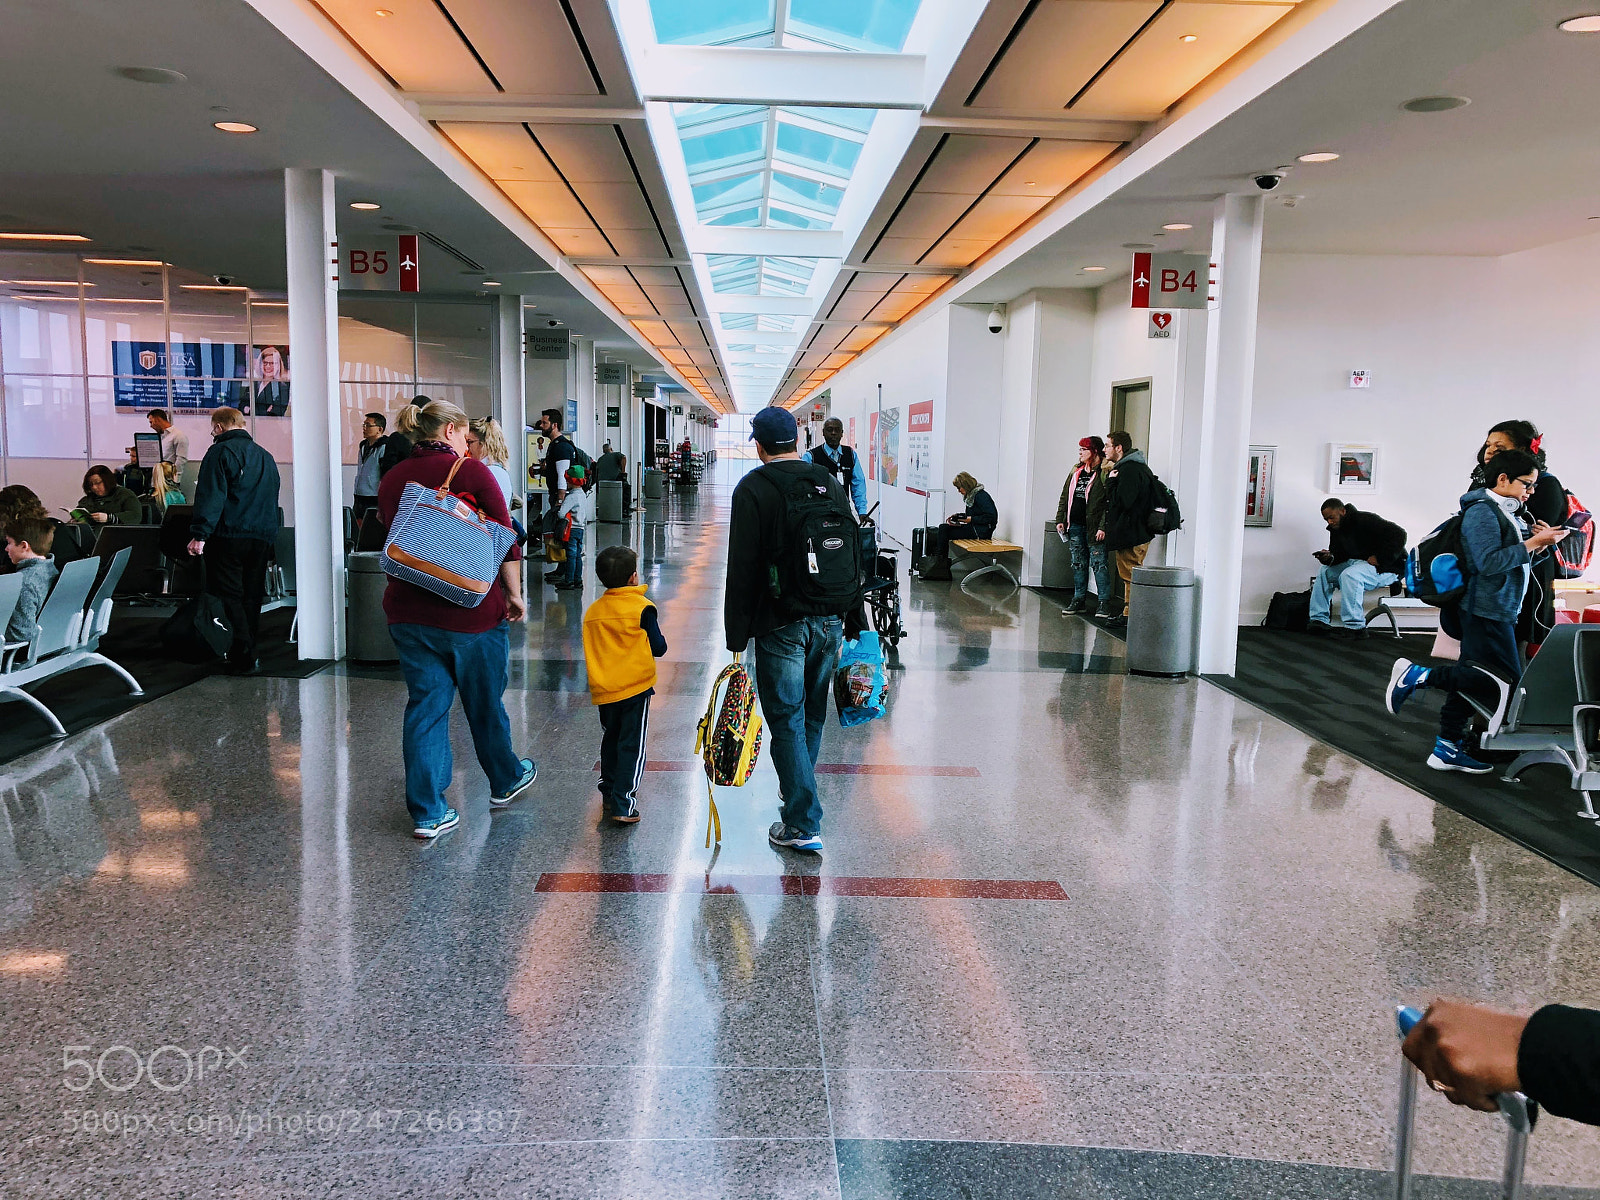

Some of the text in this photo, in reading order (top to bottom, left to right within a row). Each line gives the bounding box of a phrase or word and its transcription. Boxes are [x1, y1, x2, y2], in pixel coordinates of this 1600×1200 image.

[349, 249, 389, 275] B5
[1160, 268, 1198, 293] B4
[529, 335, 568, 343] Business
[534, 344, 563, 352] Center
